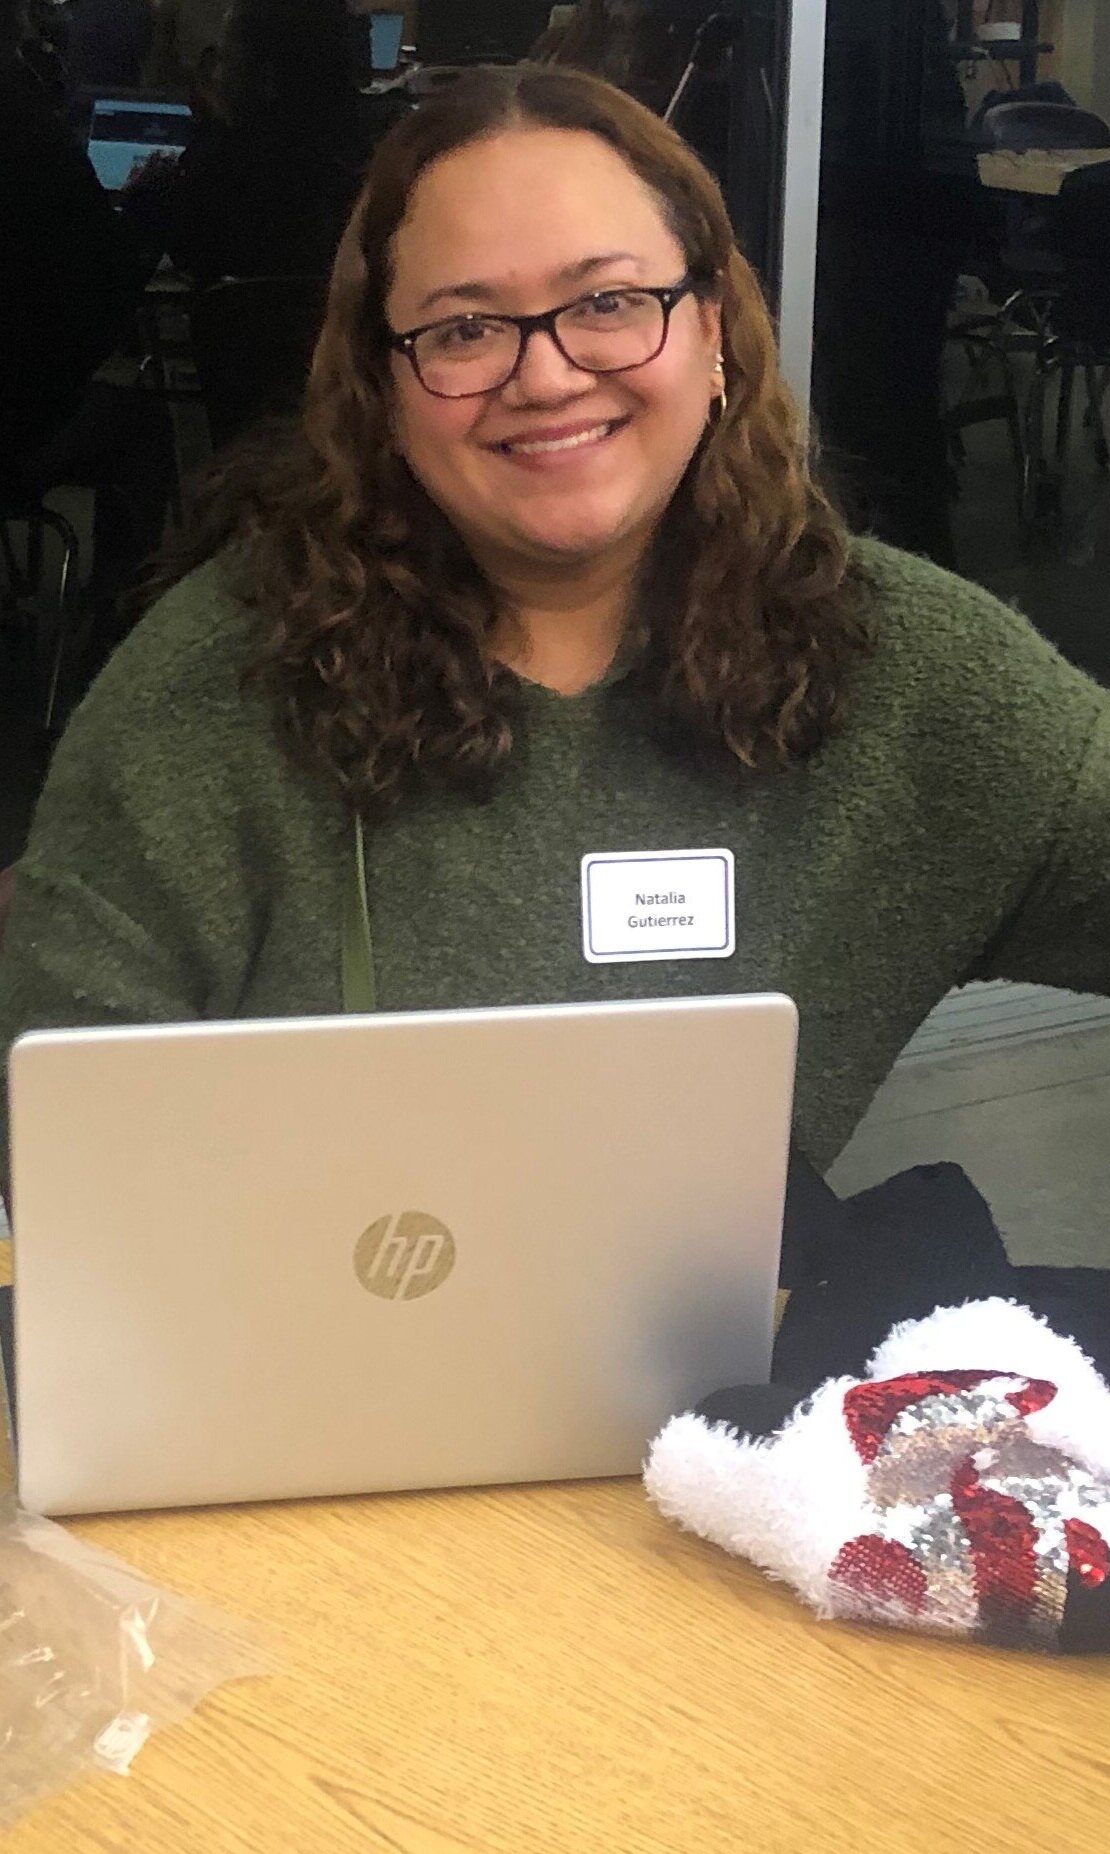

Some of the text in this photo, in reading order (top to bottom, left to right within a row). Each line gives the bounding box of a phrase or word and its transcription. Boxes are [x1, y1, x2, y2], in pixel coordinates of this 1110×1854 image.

[635, 892, 686, 905] Natalia
[627, 915, 695, 928] Gutierrez
[366, 1211, 445, 1300] hp
